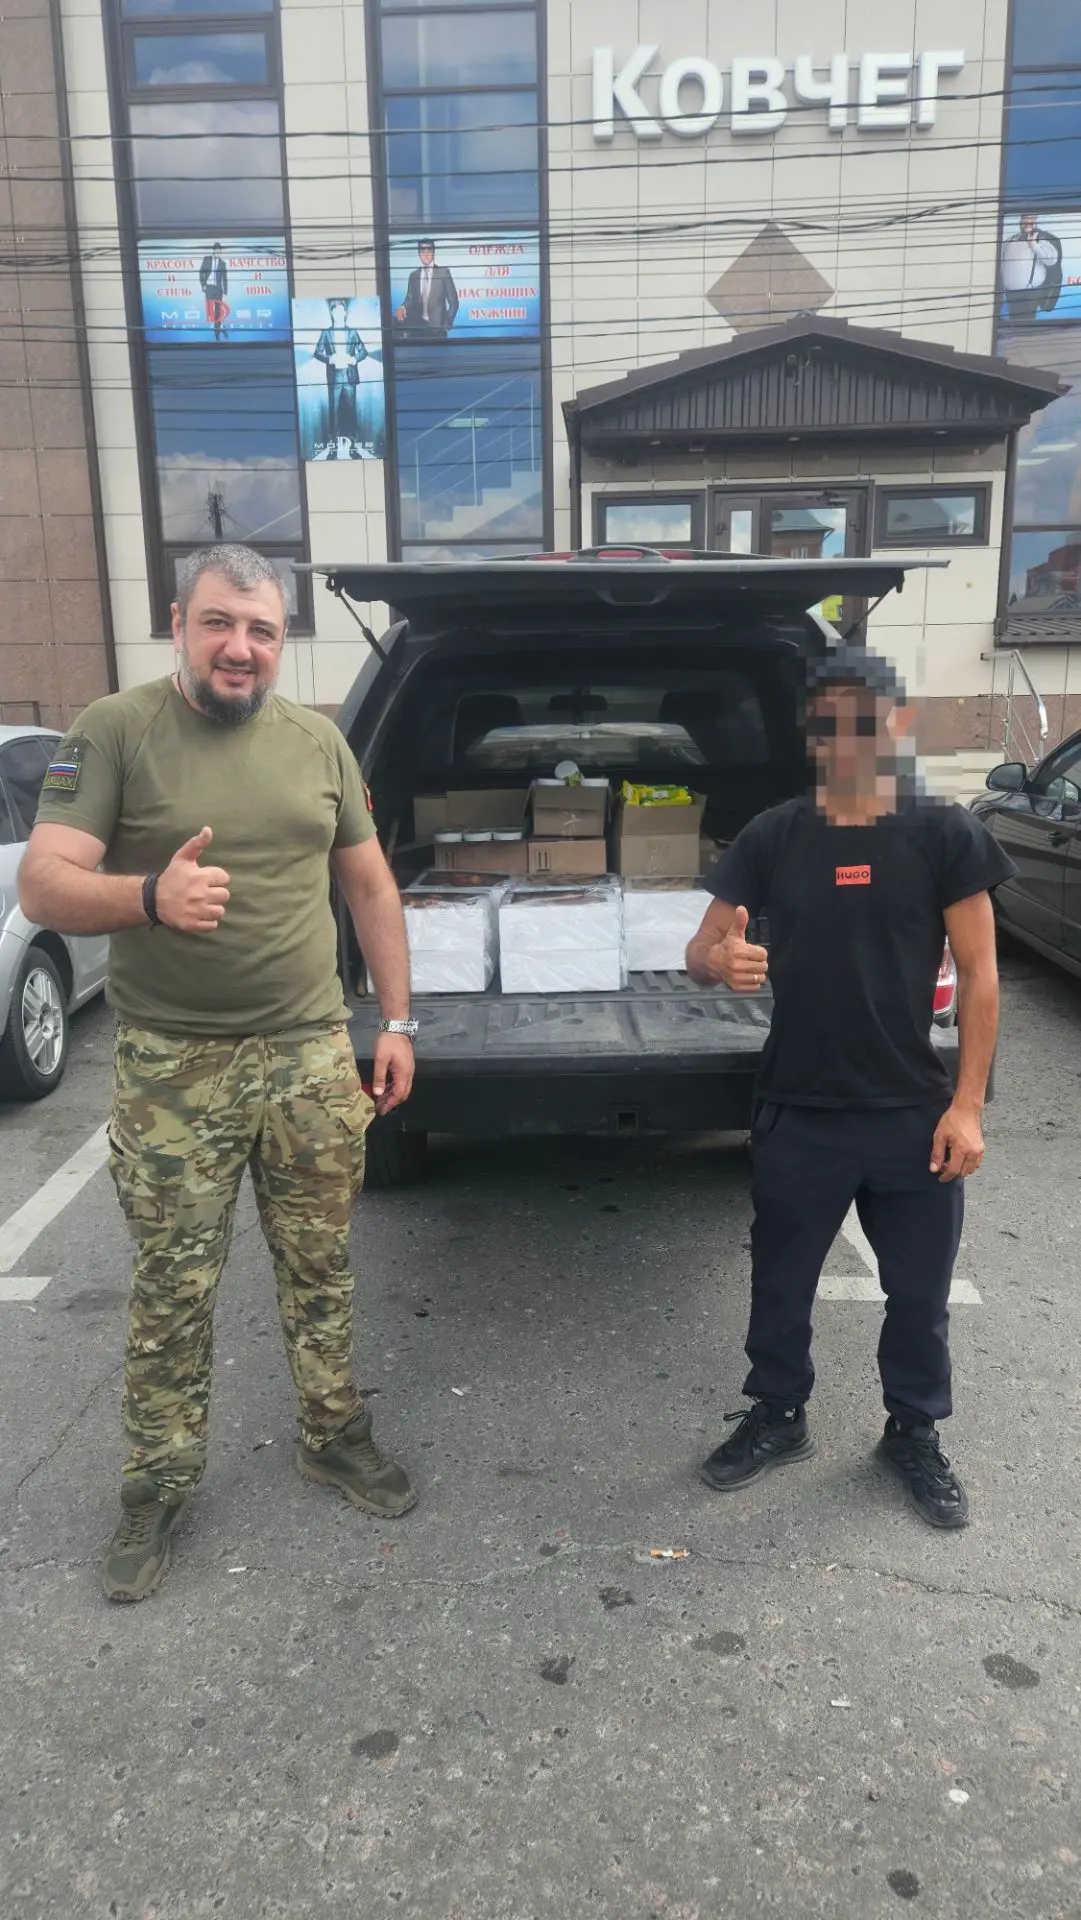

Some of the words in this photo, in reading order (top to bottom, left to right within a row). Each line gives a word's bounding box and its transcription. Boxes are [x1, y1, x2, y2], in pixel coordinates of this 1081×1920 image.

[592, 44, 966, 140] КОВЧЕГ
[468, 244, 525, 255] ОДЕЖДА
[147, 259, 194, 269] КРАСОТА
[229, 257, 286, 268] КАЧЕСТВО
[254, 272, 262, 280] И
[484, 266, 510, 277] ДЛЯ
[167, 274, 176, 283] И
[157, 288, 192, 297] СТИЛЬ
[246, 286, 272, 295] ШИК
[458, 287, 537, 298] НАСТОЯЩИХ
[471, 308, 526, 319] МУЖЧИН
[837, 871, 869, 879] HUGO
